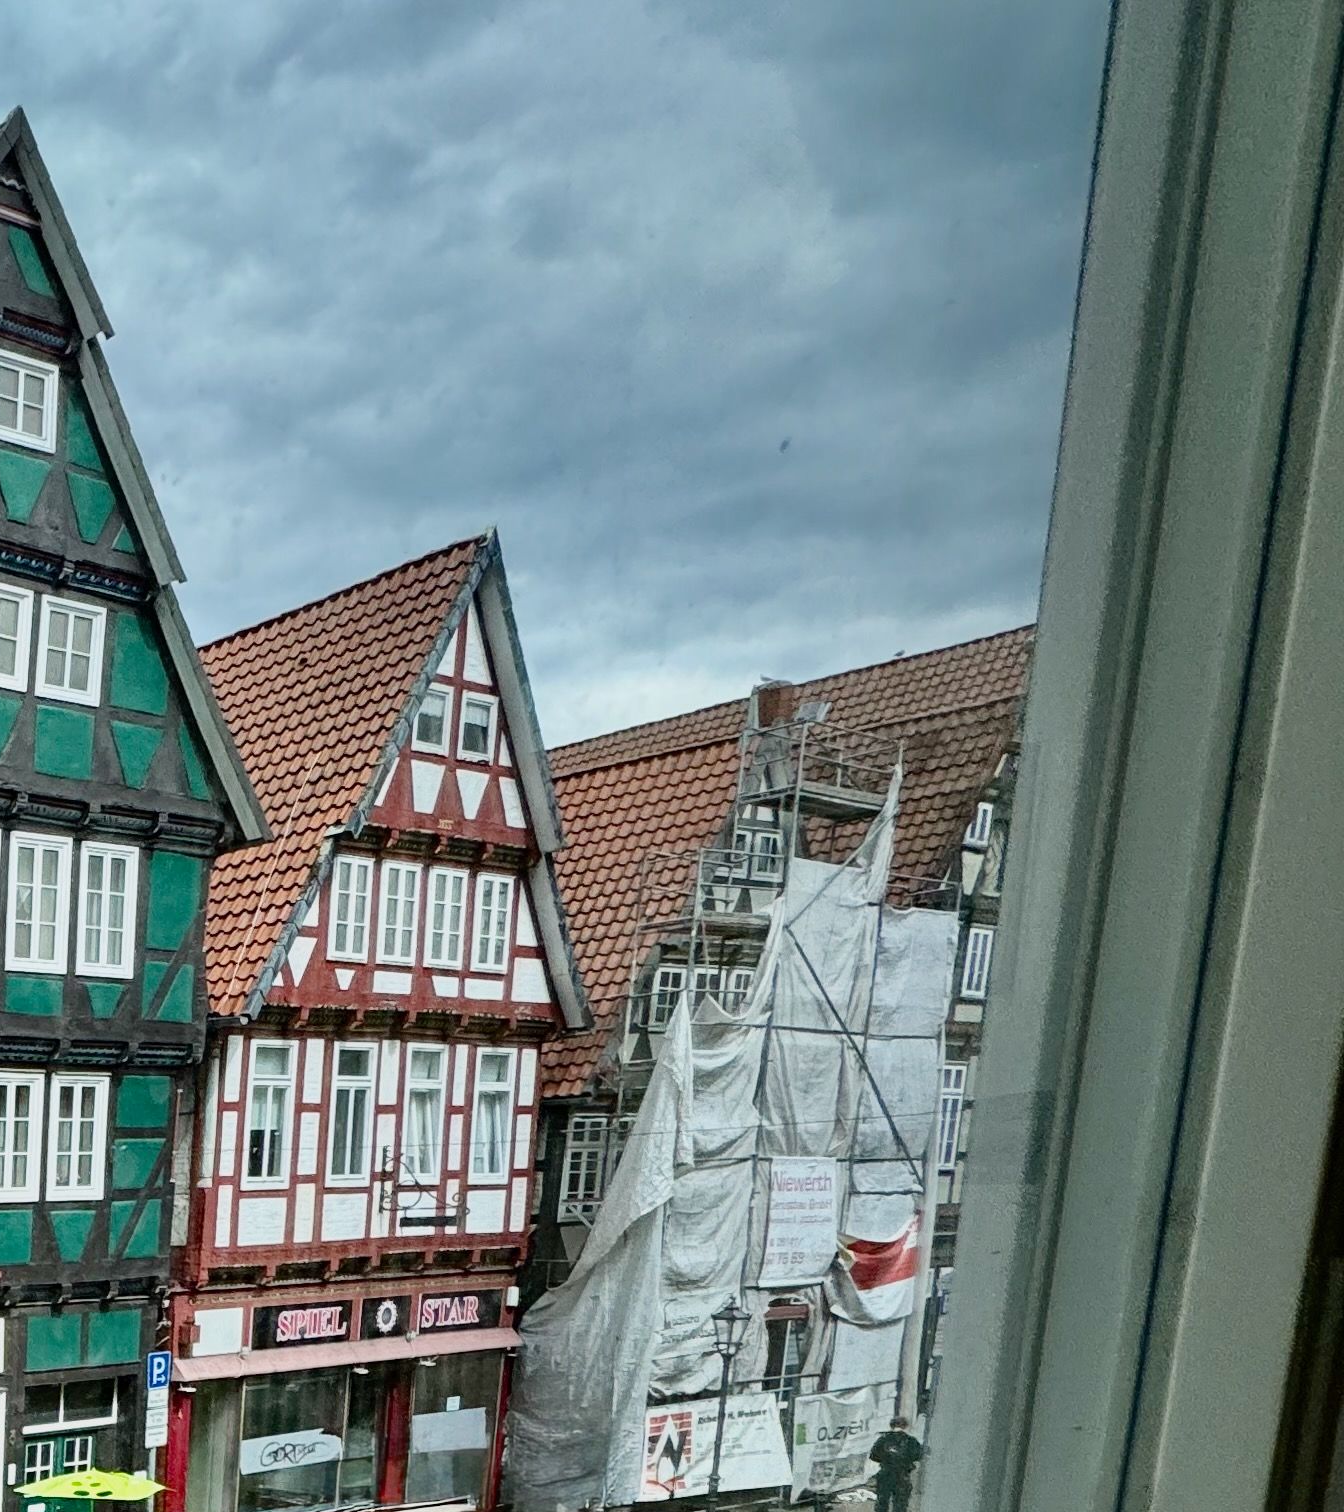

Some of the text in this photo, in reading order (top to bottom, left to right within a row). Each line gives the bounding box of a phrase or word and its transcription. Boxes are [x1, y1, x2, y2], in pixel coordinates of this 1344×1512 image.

[276, 1295, 480, 1343] SPIEL STAR
[152, 1357, 166, 1385] P
